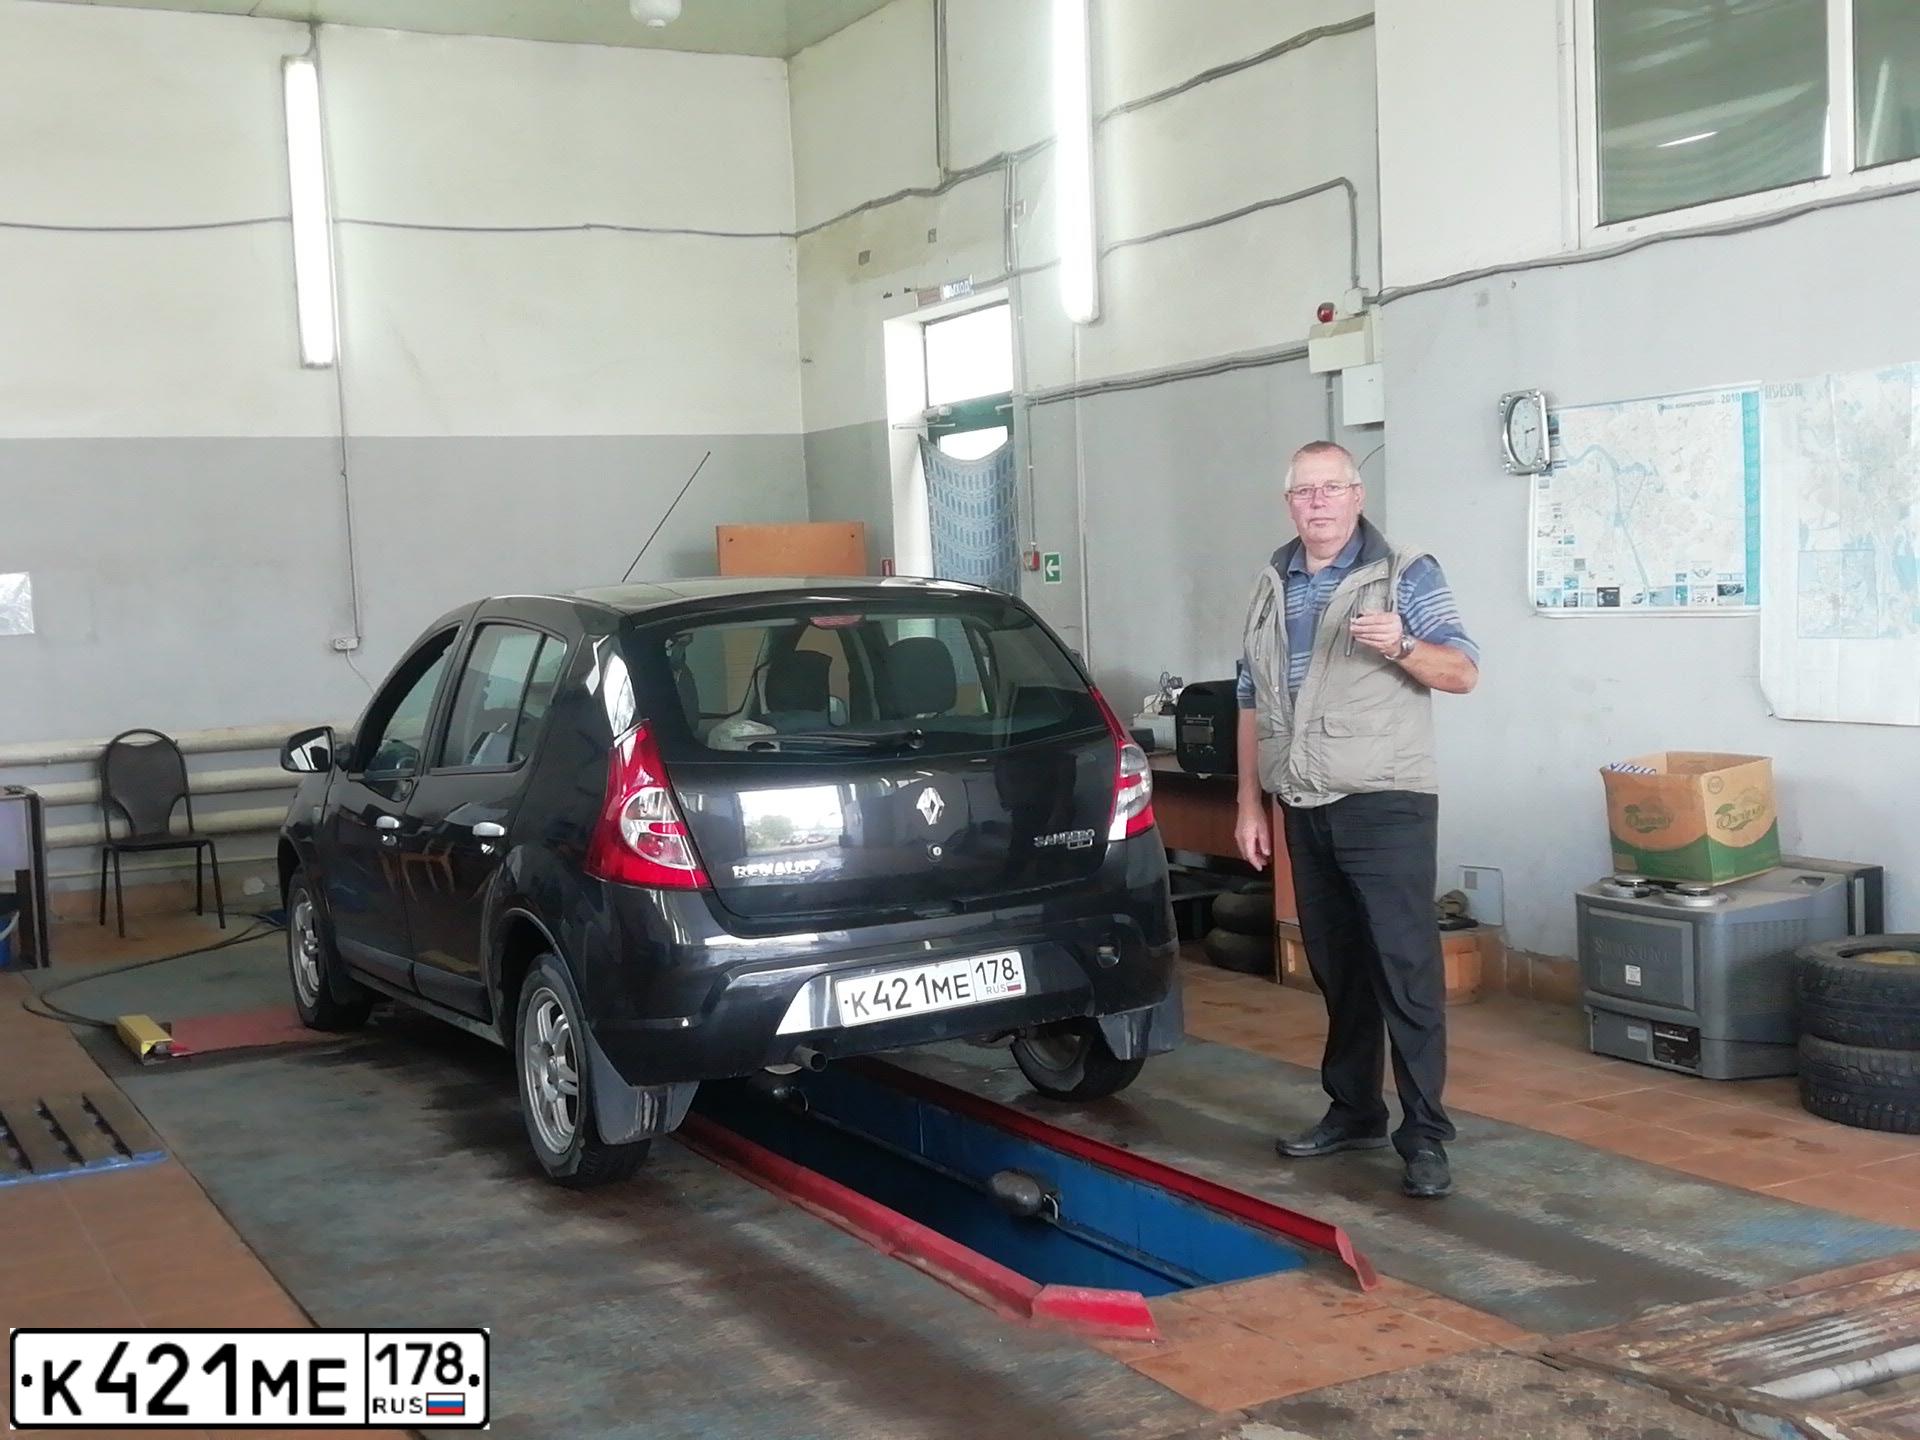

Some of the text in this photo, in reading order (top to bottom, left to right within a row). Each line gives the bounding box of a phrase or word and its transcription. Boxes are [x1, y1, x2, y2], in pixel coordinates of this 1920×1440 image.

[732, 859, 821, 879] RENAULT
[975, 957, 1015, 986] 178
[986, 984, 1007, 994] RUS
